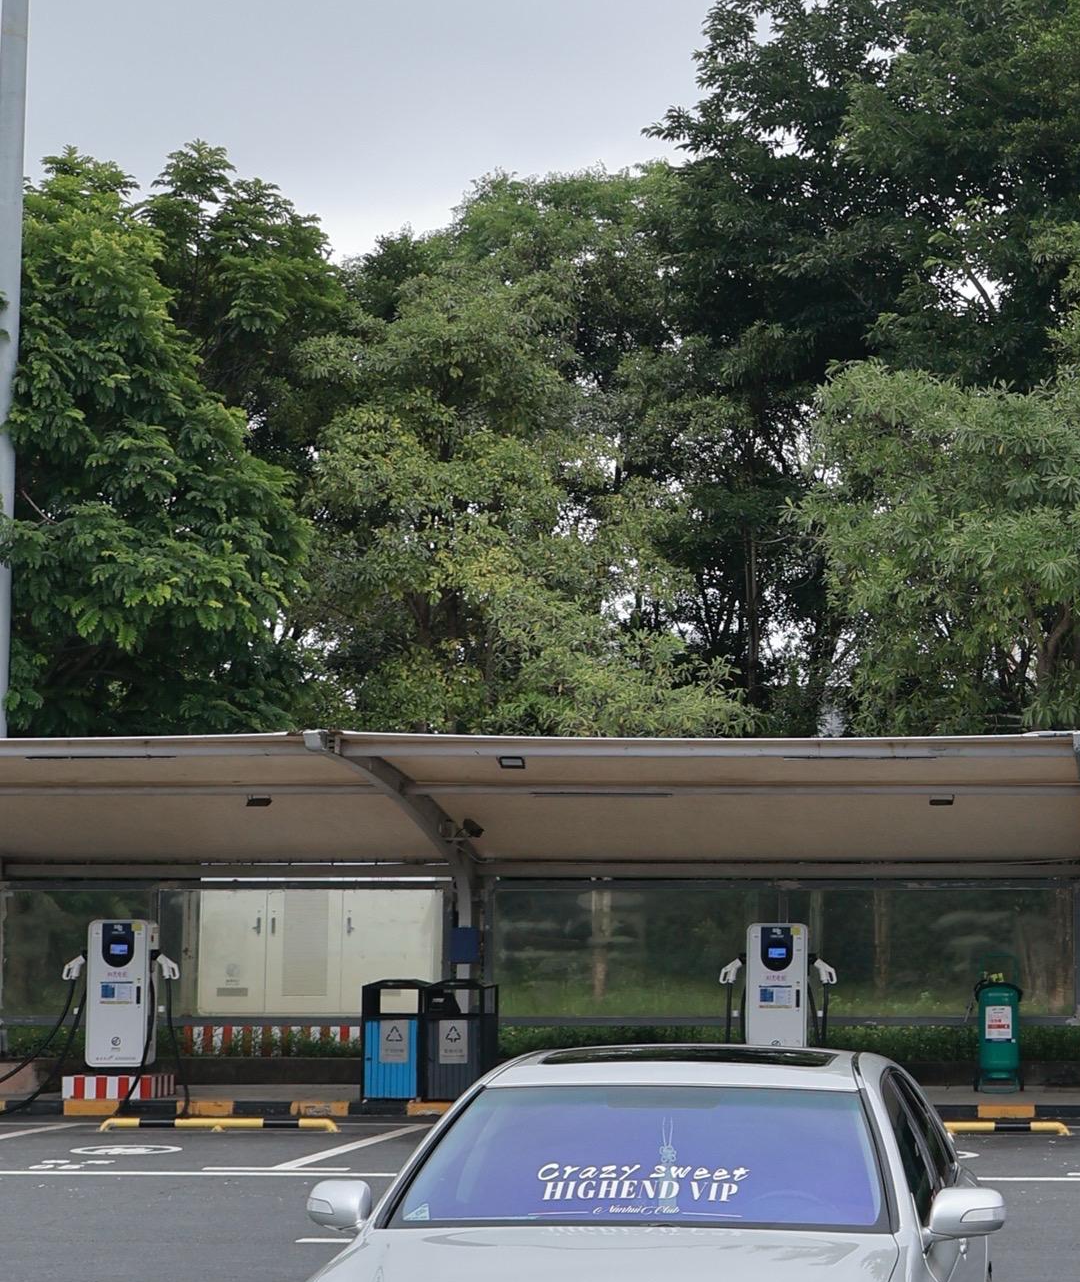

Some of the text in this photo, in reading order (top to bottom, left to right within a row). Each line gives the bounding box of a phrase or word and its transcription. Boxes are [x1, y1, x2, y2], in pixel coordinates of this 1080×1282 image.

[537, 1163, 640, 1181] Crazy
[541, 1179, 739, 1203] HIGHEND VIP
